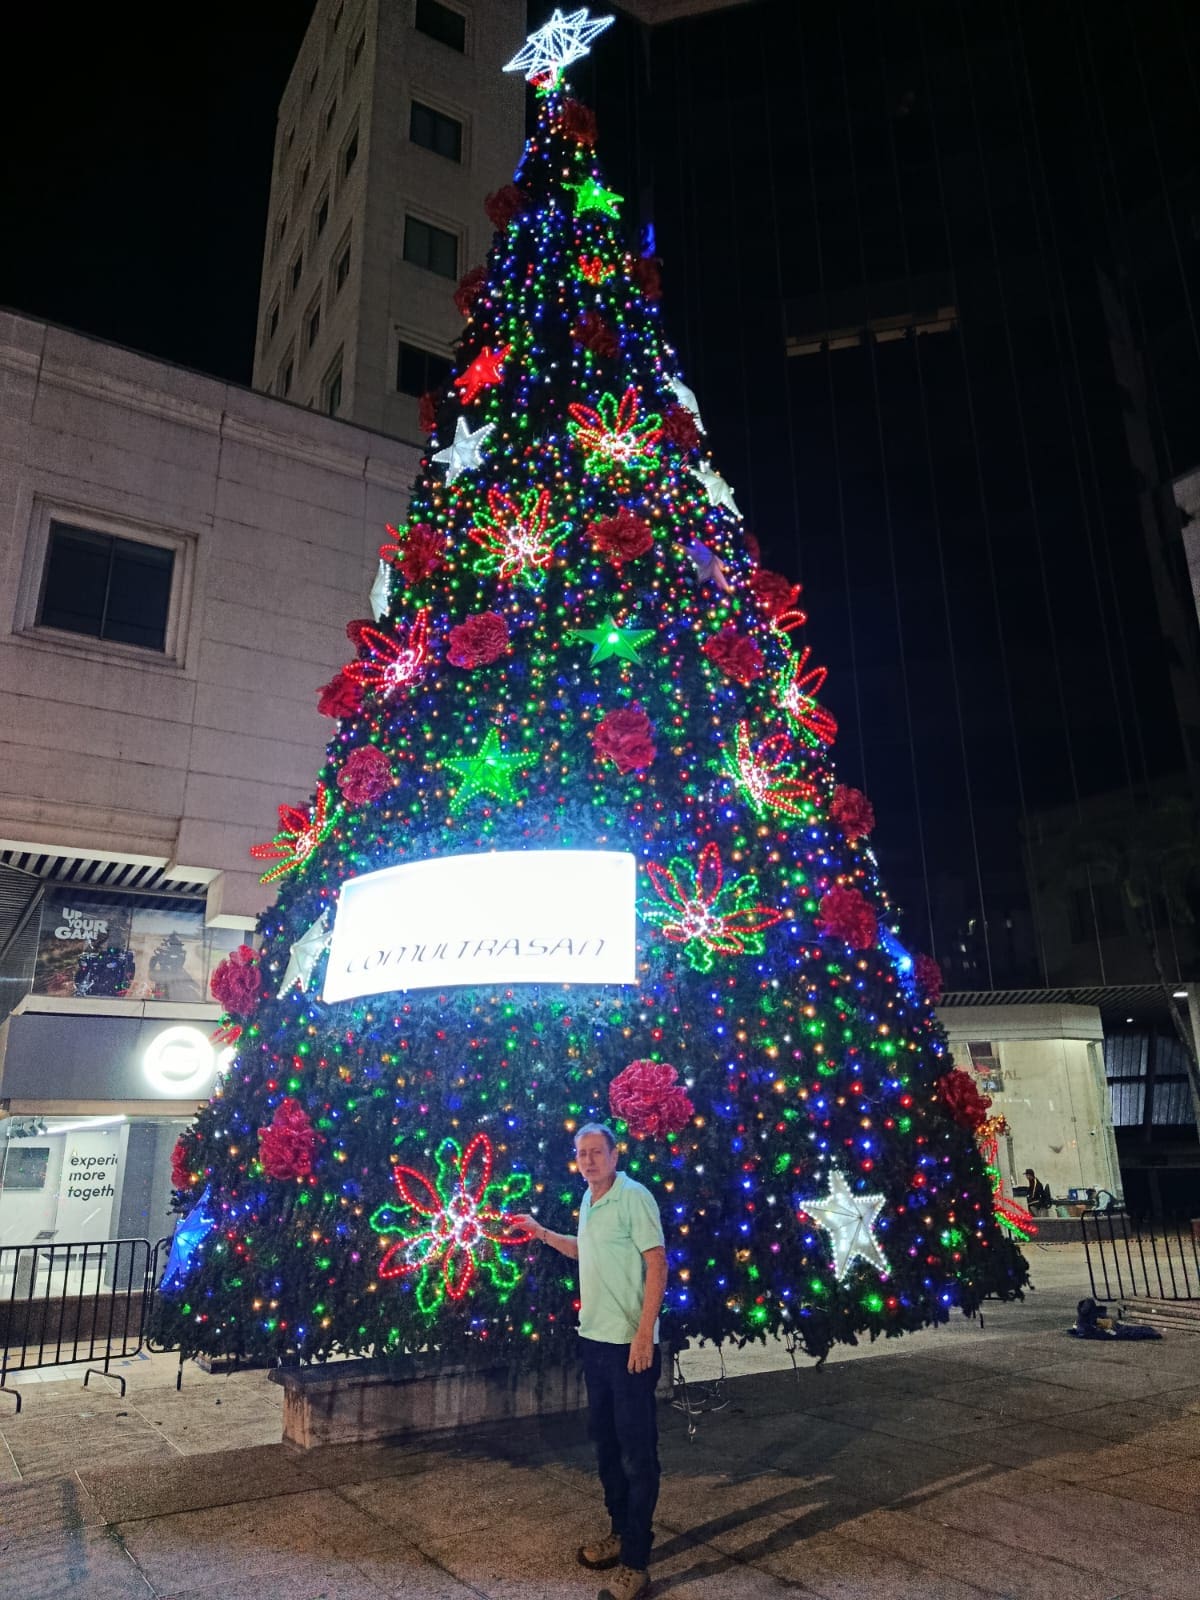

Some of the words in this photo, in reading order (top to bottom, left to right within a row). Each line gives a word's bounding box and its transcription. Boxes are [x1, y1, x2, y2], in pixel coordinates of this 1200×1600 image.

[62, 907, 83, 920] UP
[54, 926, 98, 940] GAME
[68, 919, 108, 934] YOUR
[69, 1171, 105, 1181] more
